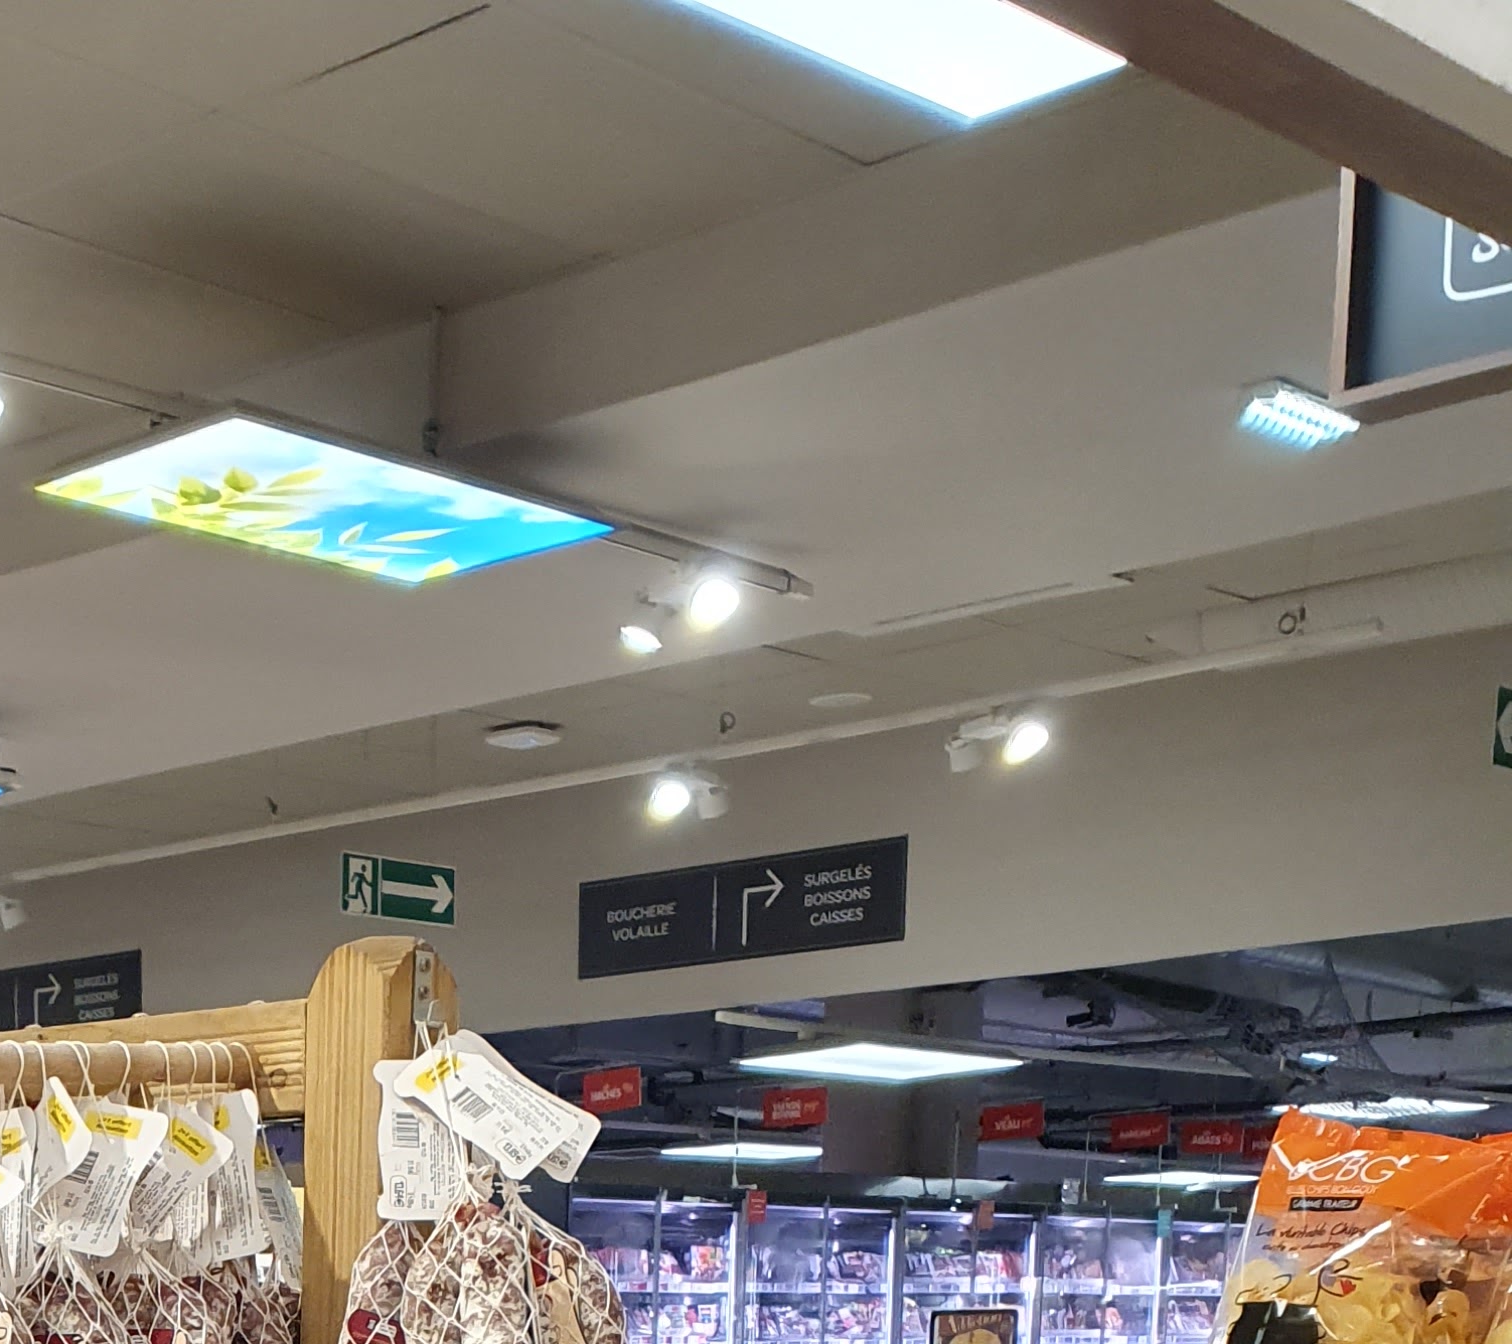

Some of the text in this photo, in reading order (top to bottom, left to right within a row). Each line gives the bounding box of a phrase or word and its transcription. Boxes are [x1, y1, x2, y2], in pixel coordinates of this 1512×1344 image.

[803, 863, 873, 888] SURGELÉS
[803, 886, 872, 908] BOISSONS
[606, 901, 678, 925] BOUCHERIE
[810, 907, 864, 927] CAISSES
[612, 922, 670, 942] VOLAILLE
